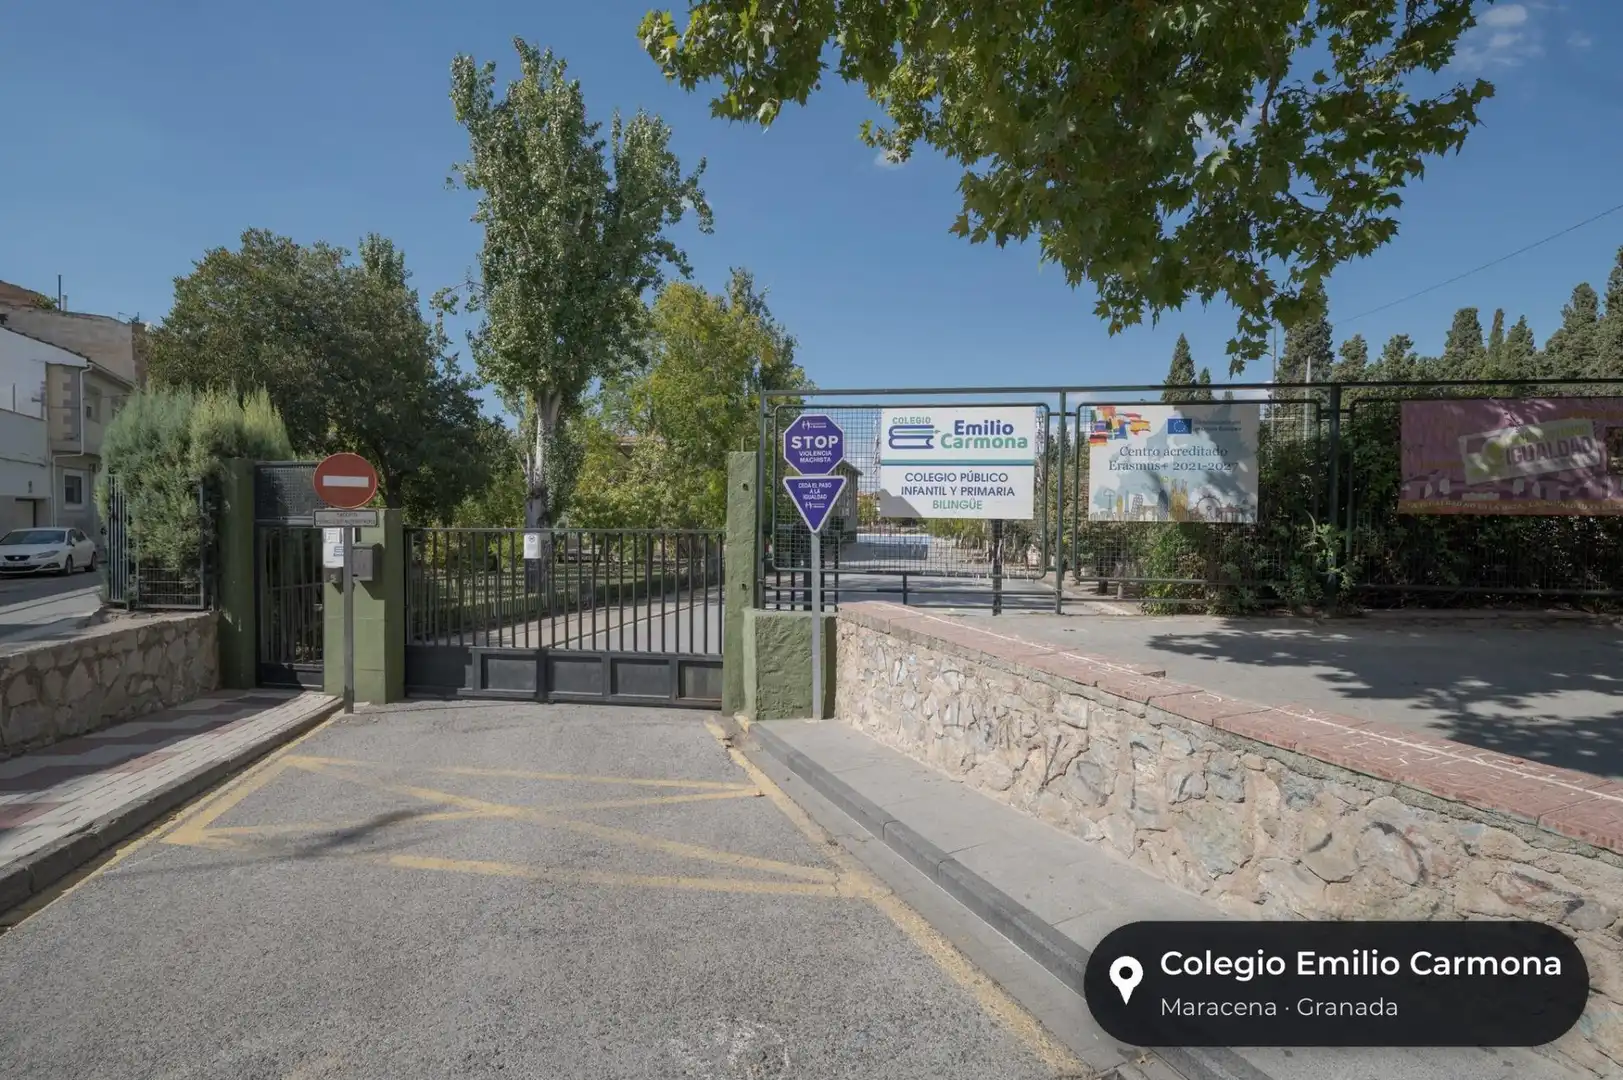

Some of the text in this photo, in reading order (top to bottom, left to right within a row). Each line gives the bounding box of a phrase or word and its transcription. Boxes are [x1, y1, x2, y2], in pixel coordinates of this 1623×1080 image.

[892, 416, 931, 425] COLEGIO
[954, 420, 1014, 436] Emilio
[791, 435, 839, 449] STOP
[940, 433, 1028, 449] Carmona
[1119, 445, 1228, 457] Centro acreditado
[1109, 460, 1168, 471] Erasmus+
[905, 470, 1009, 483] COLEGIO PÚBLICO
[901, 486, 1016, 497] INFANTIL Y PRIMARIA
[932, 498, 983, 510] BILINGÜE
